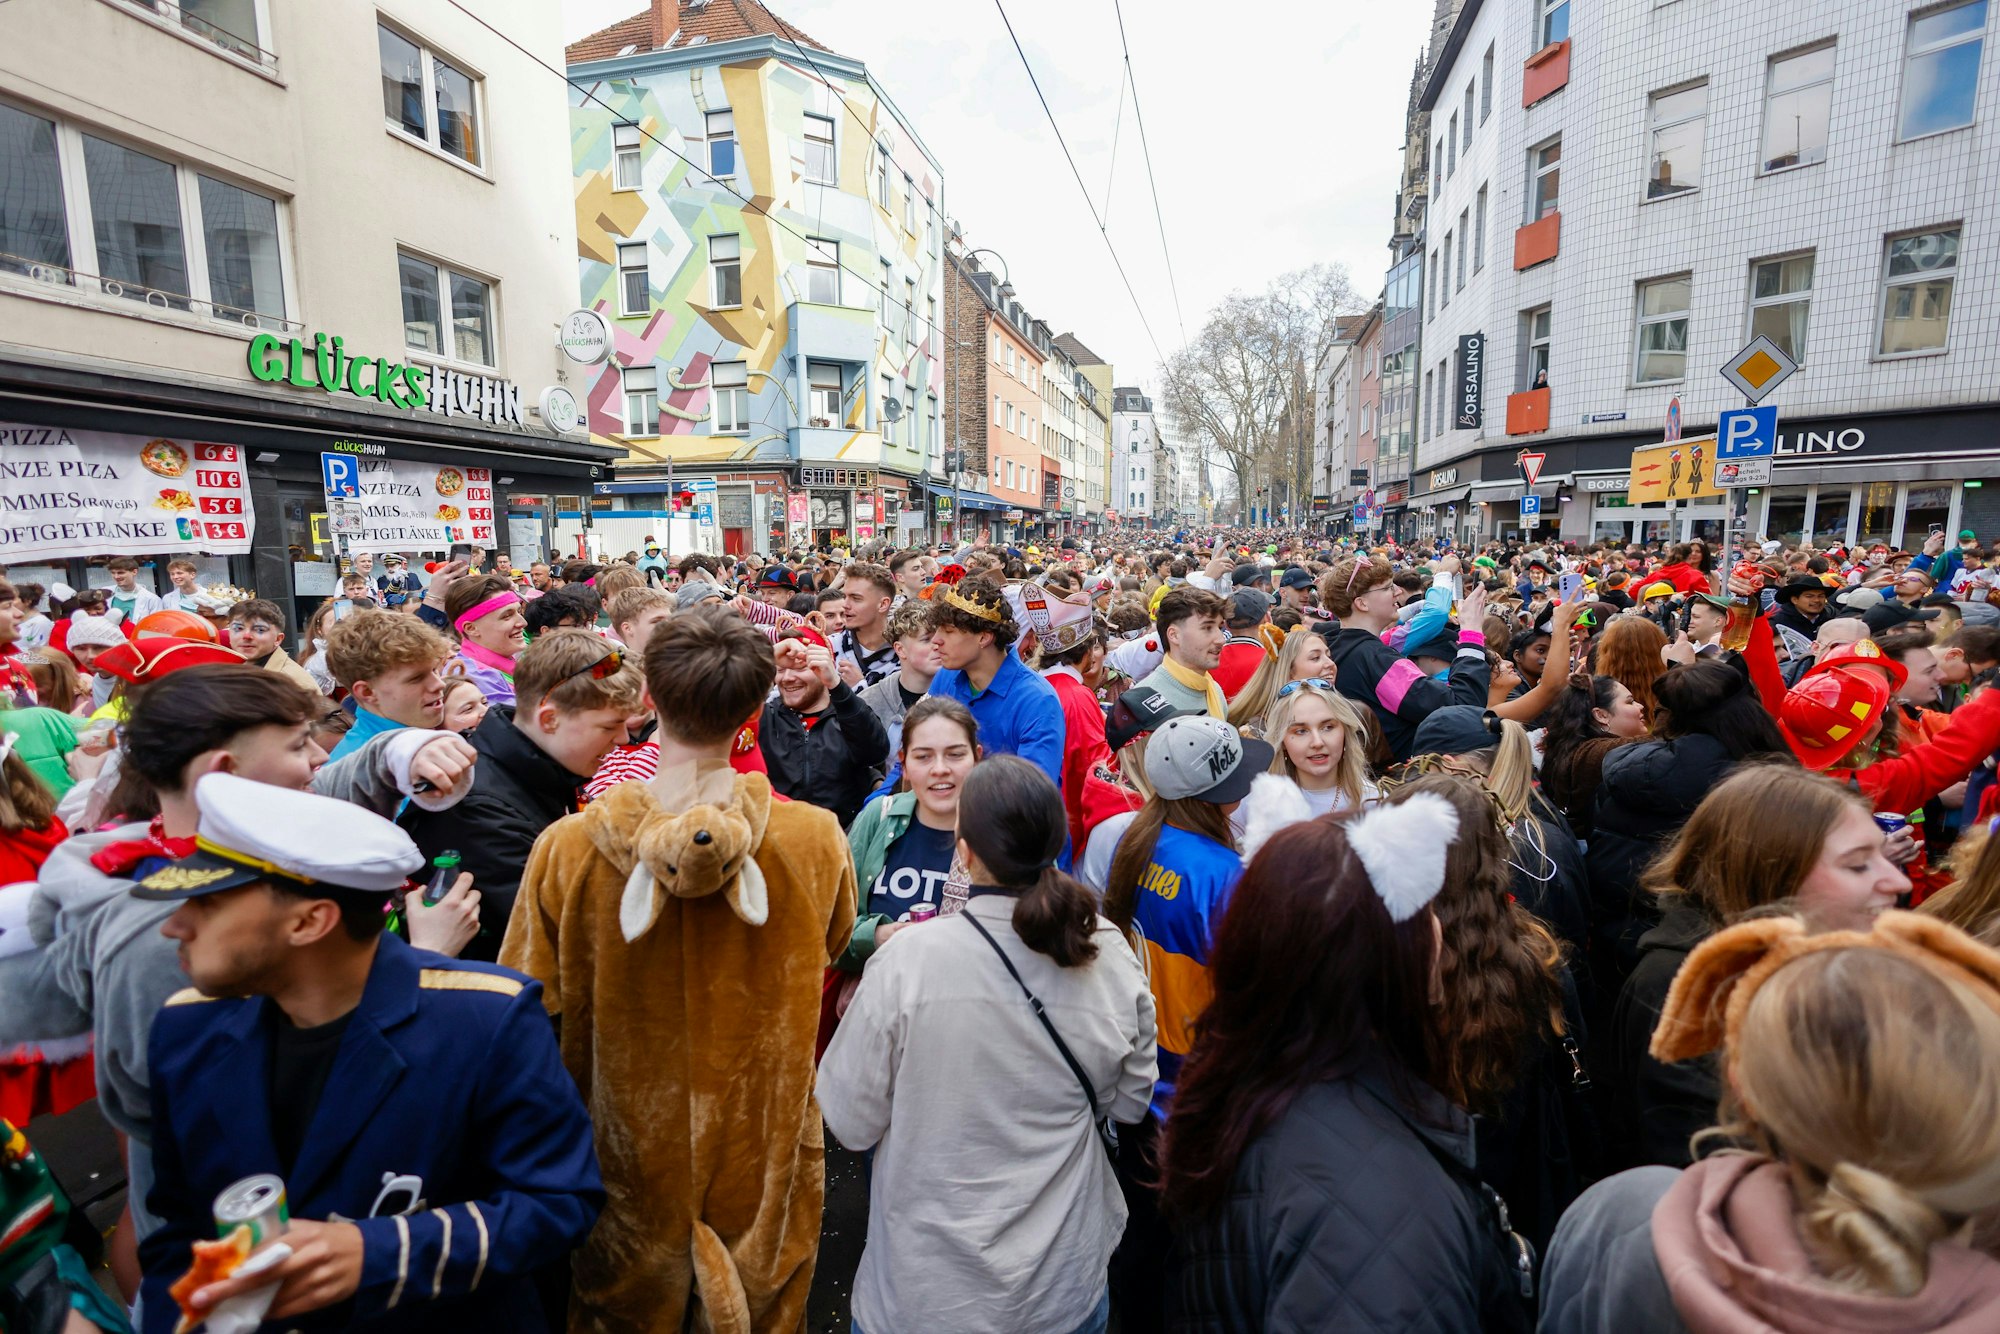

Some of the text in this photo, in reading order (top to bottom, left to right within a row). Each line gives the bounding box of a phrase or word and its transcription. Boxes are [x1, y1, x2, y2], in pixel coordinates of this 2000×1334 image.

[564, 336, 603, 347] GLÜCKSHUHN
[247, 332, 523, 424] GLÜCKSHUHN
[1460, 337, 1480, 427] BORSALINO
[0, 429, 75, 446] PIZZA
[1726, 415, 1758, 452] P
[1776, 428, 1865, 454] LINO
[204, 446, 234, 460] 6 €
[334, 440, 386, 455] GLÜCKSHUHN
[198, 471, 239, 487] 10 €
[328, 458, 349, 492] P
[471, 469, 486, 481] 6 €
[468, 488, 490, 500] 10 €
[209, 498, 236, 513] 5 €
[1524, 498, 1536, 512] P
[475, 508, 490, 520] 5 €
[212, 523, 223, 538] 3
[227, 523, 240, 538] €
[476, 527, 483, 538] 3
[1209, 742, 1239, 782] Nets
